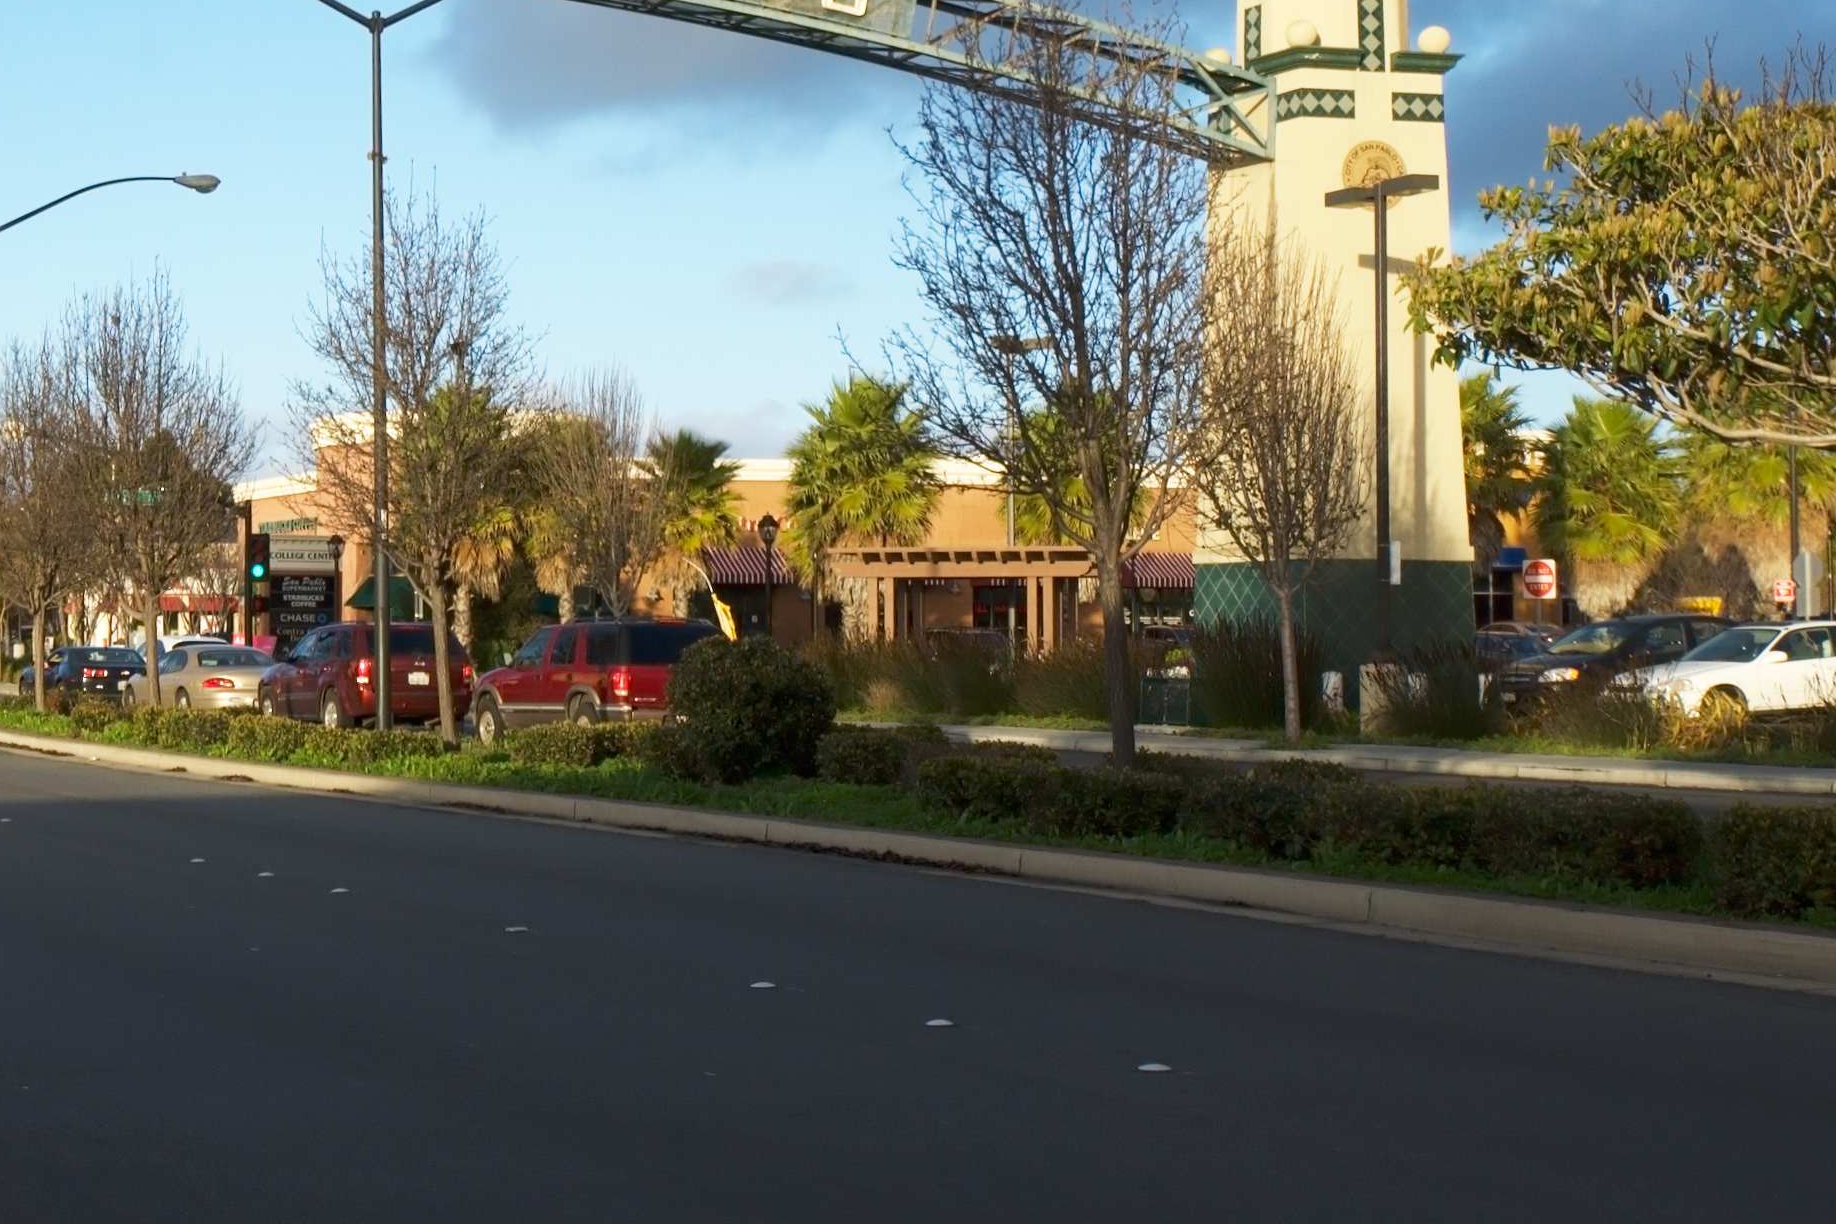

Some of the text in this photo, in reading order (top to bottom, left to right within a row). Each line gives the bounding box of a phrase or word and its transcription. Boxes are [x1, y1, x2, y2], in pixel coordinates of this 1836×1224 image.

[1360, 144, 1375, 153] SAN
[1375, 144, 1398, 162] PABLO
[270, 551, 305, 559] COLLEGE
[282, 577, 326, 587] San Pablo
[280, 613, 316, 623] CHASE
[276, 628, 304, 636] Contra
